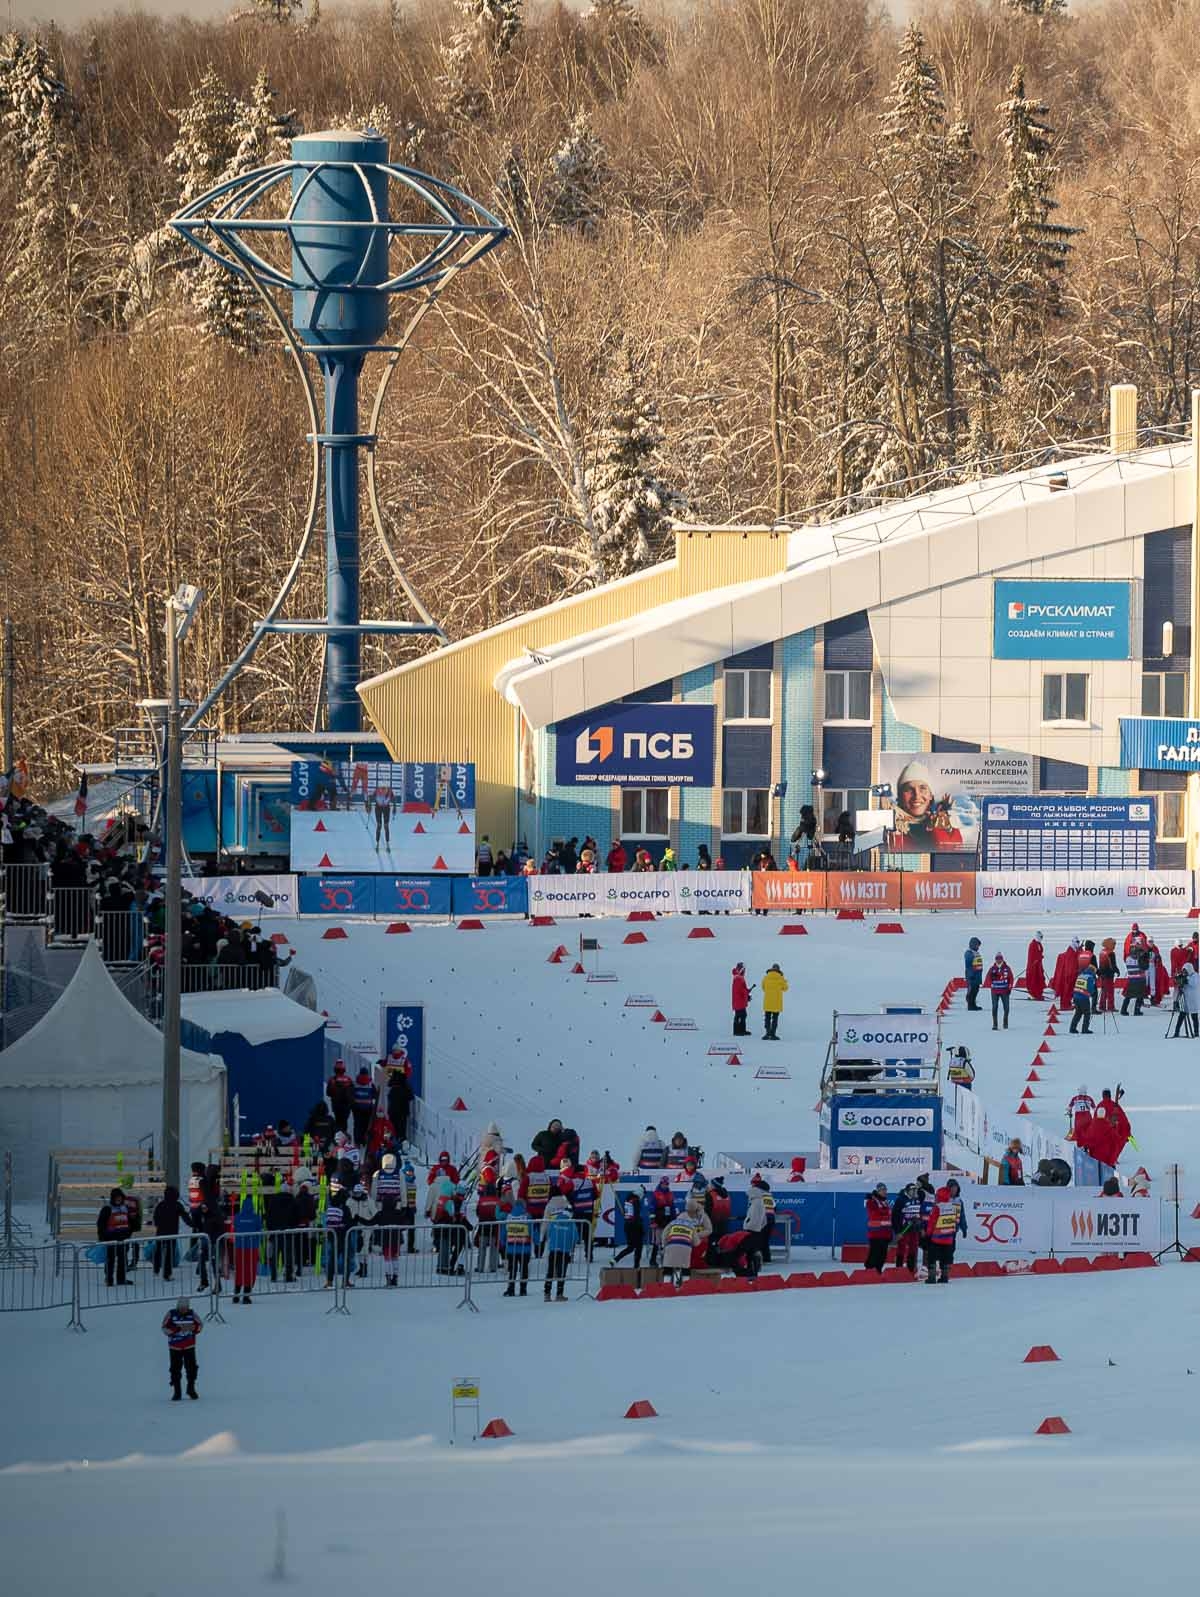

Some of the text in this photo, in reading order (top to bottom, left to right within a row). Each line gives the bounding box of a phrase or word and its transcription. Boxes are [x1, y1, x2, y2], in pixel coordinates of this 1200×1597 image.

[1027, 605, 1116, 617] РУСКЛИМАТ
[1046, 630, 1077, 638] КЛИМАТ
[1086, 630, 1115, 638] СТРАНЕ
[622, 732, 695, 760] ПСБ
[984, 759, 1028, 767] КУЛАКОВА
[940, 768, 1028, 776] ГАЛИНА АЛЕКСЕЕВНА
[413, 762, 424, 798] АГРО
[455, 762, 467, 800] АГРО
[545, 891, 596, 901] ФОСАГРО
[619, 890, 670, 900] ФОСАГРО
[693, 888, 743, 898] ФОСАГРО
[783, 882, 814, 898] ИЗТТ
[857, 882, 888, 899] ИЗТТ
[932, 882, 963, 899] ИЗТТ
[994, 886, 1042, 898] ЛУКОЙЛ
[1067, 886, 1114, 897] ЛУКОЙЛ
[1138, 886, 1186, 897] ЛУКОЙЛ
[861, 1031, 930, 1044] ФОСАГРО
[859, 1114, 927, 1128] ФОСАГРО
[1096, 1213, 1140, 1237] ИЗТТ
